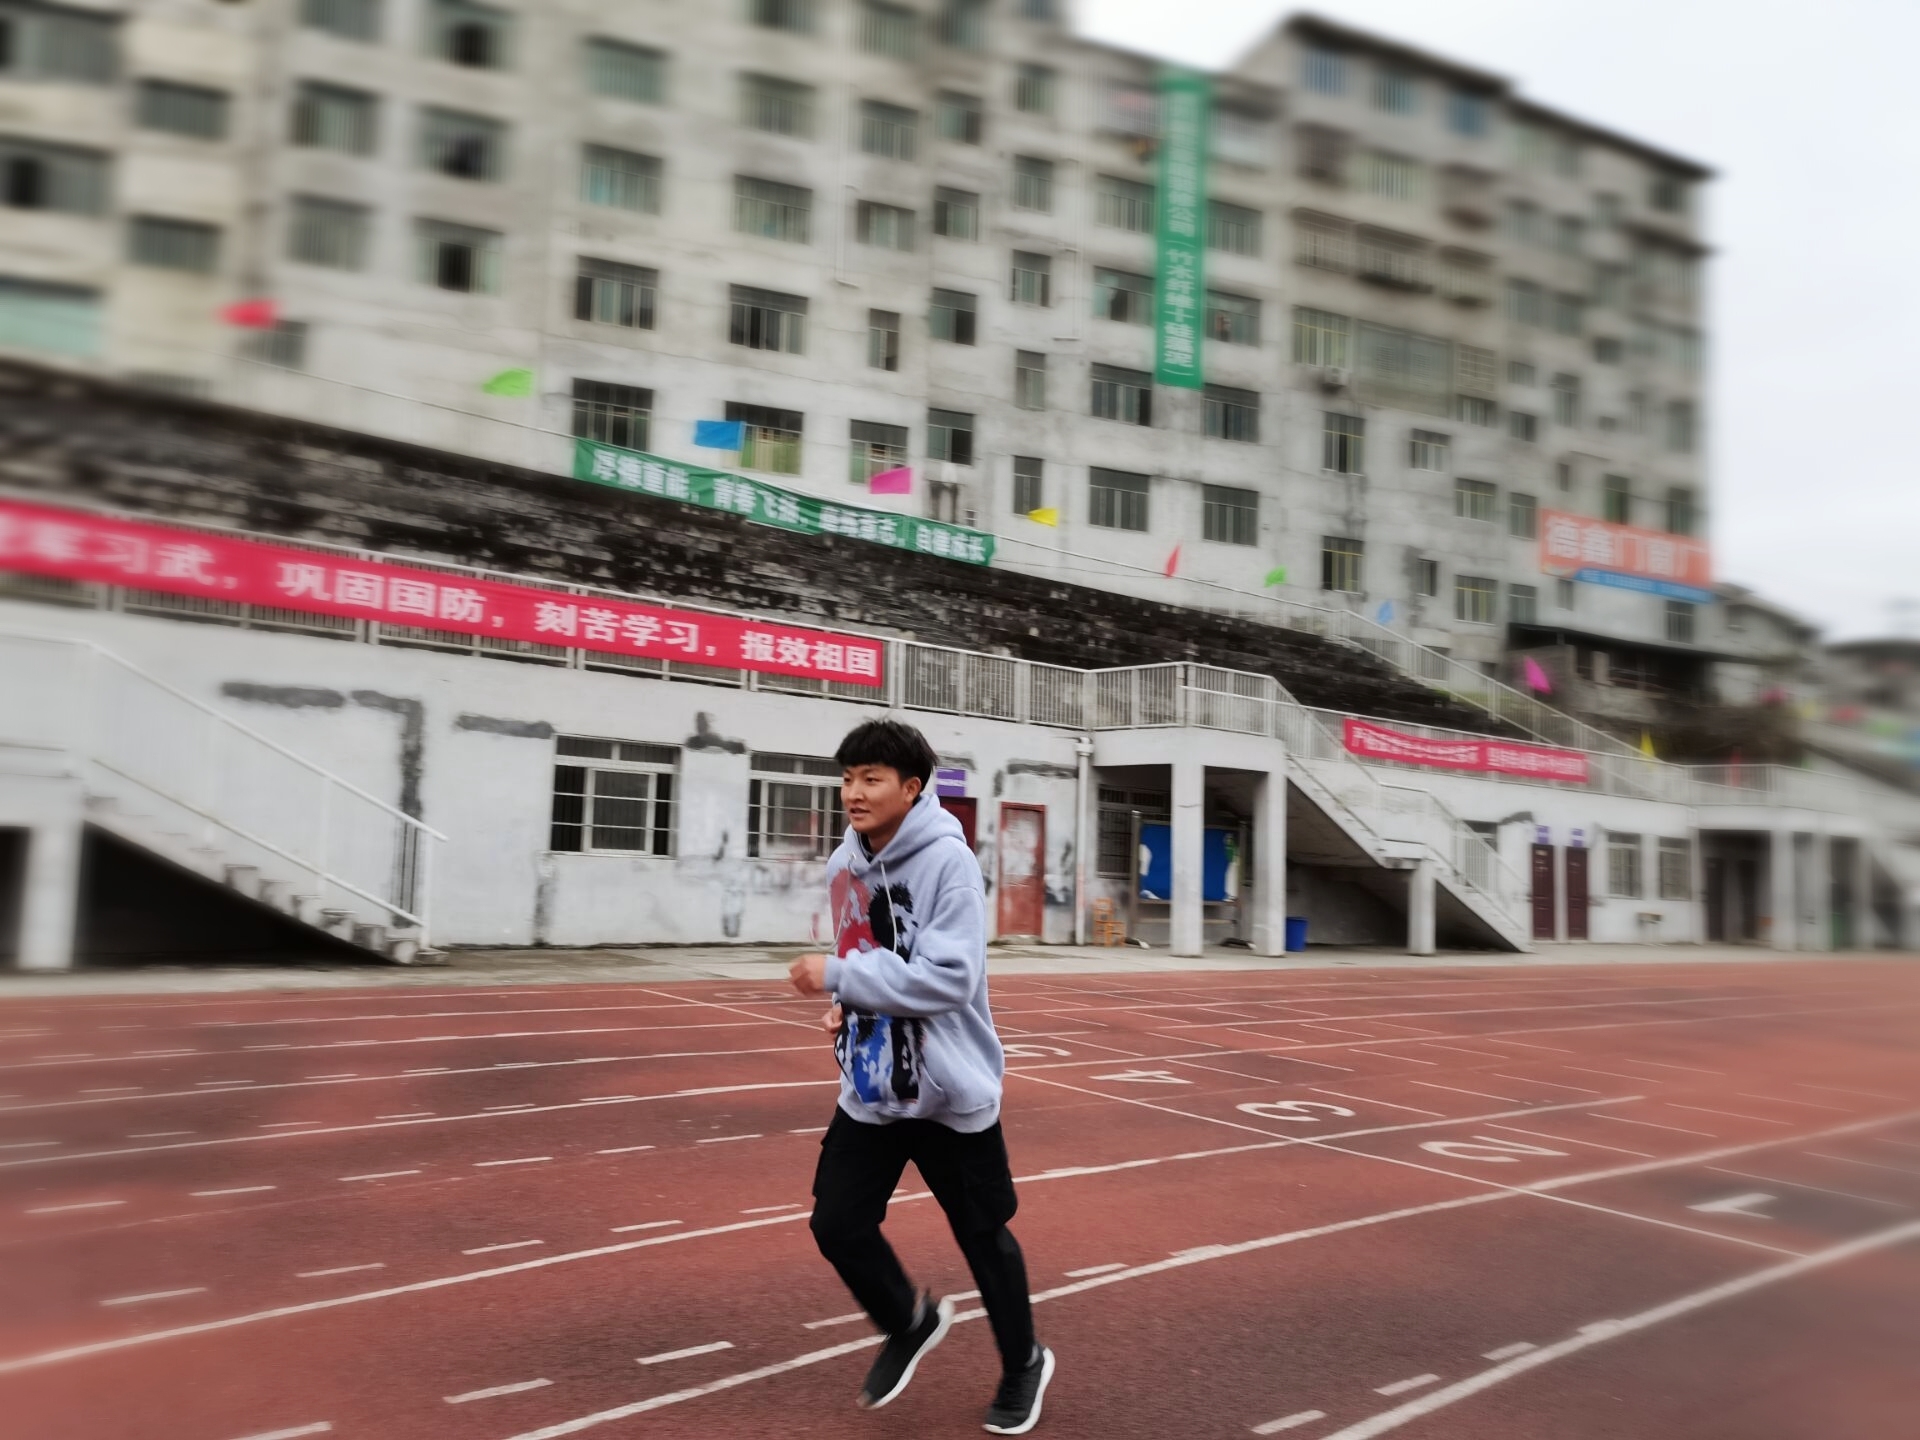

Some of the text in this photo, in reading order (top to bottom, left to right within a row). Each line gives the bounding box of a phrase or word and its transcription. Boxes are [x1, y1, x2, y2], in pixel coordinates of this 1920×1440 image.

[1089, 1069, 1195, 1085] 4
[1235, 1100, 1356, 1122] 3
[1418, 1135, 1571, 1162] 2
